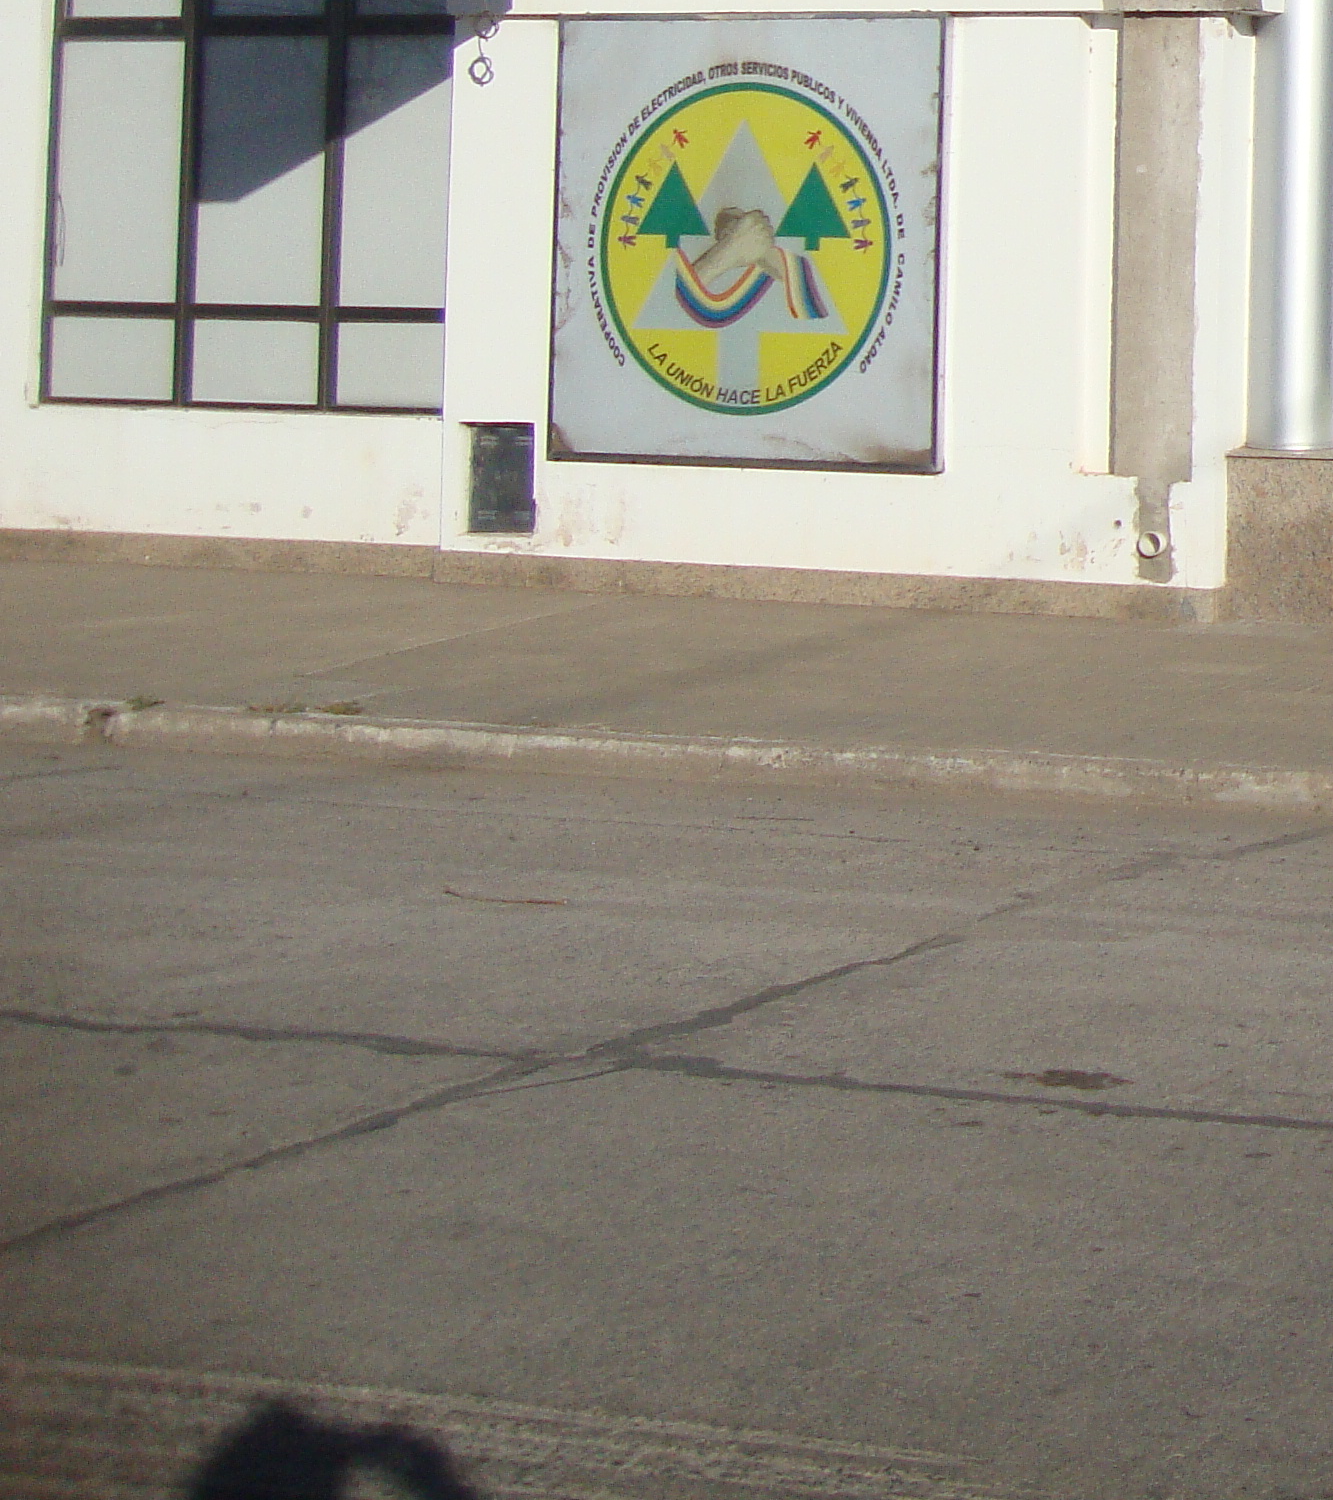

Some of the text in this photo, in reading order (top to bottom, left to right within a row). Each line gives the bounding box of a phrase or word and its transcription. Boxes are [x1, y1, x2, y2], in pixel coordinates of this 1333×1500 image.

[708, 62, 738, 80] OTROS
[741, 61, 789, 80] SERVICIOS
[838, 96, 845, 109] Y
[627, 115, 641, 136] DE
[846, 104, 883, 160] VIVIENDA
[591, 133, 628, 218] PROVISION
[587, 223, 596, 249] DE
[896, 213, 905, 239] DE
[885, 253, 905, 326] CAMILO
[587, 256, 625, 367] COOPERATIVA
[647, 341, 844, 405] LA UNIÓN HACE LA FUERZA
